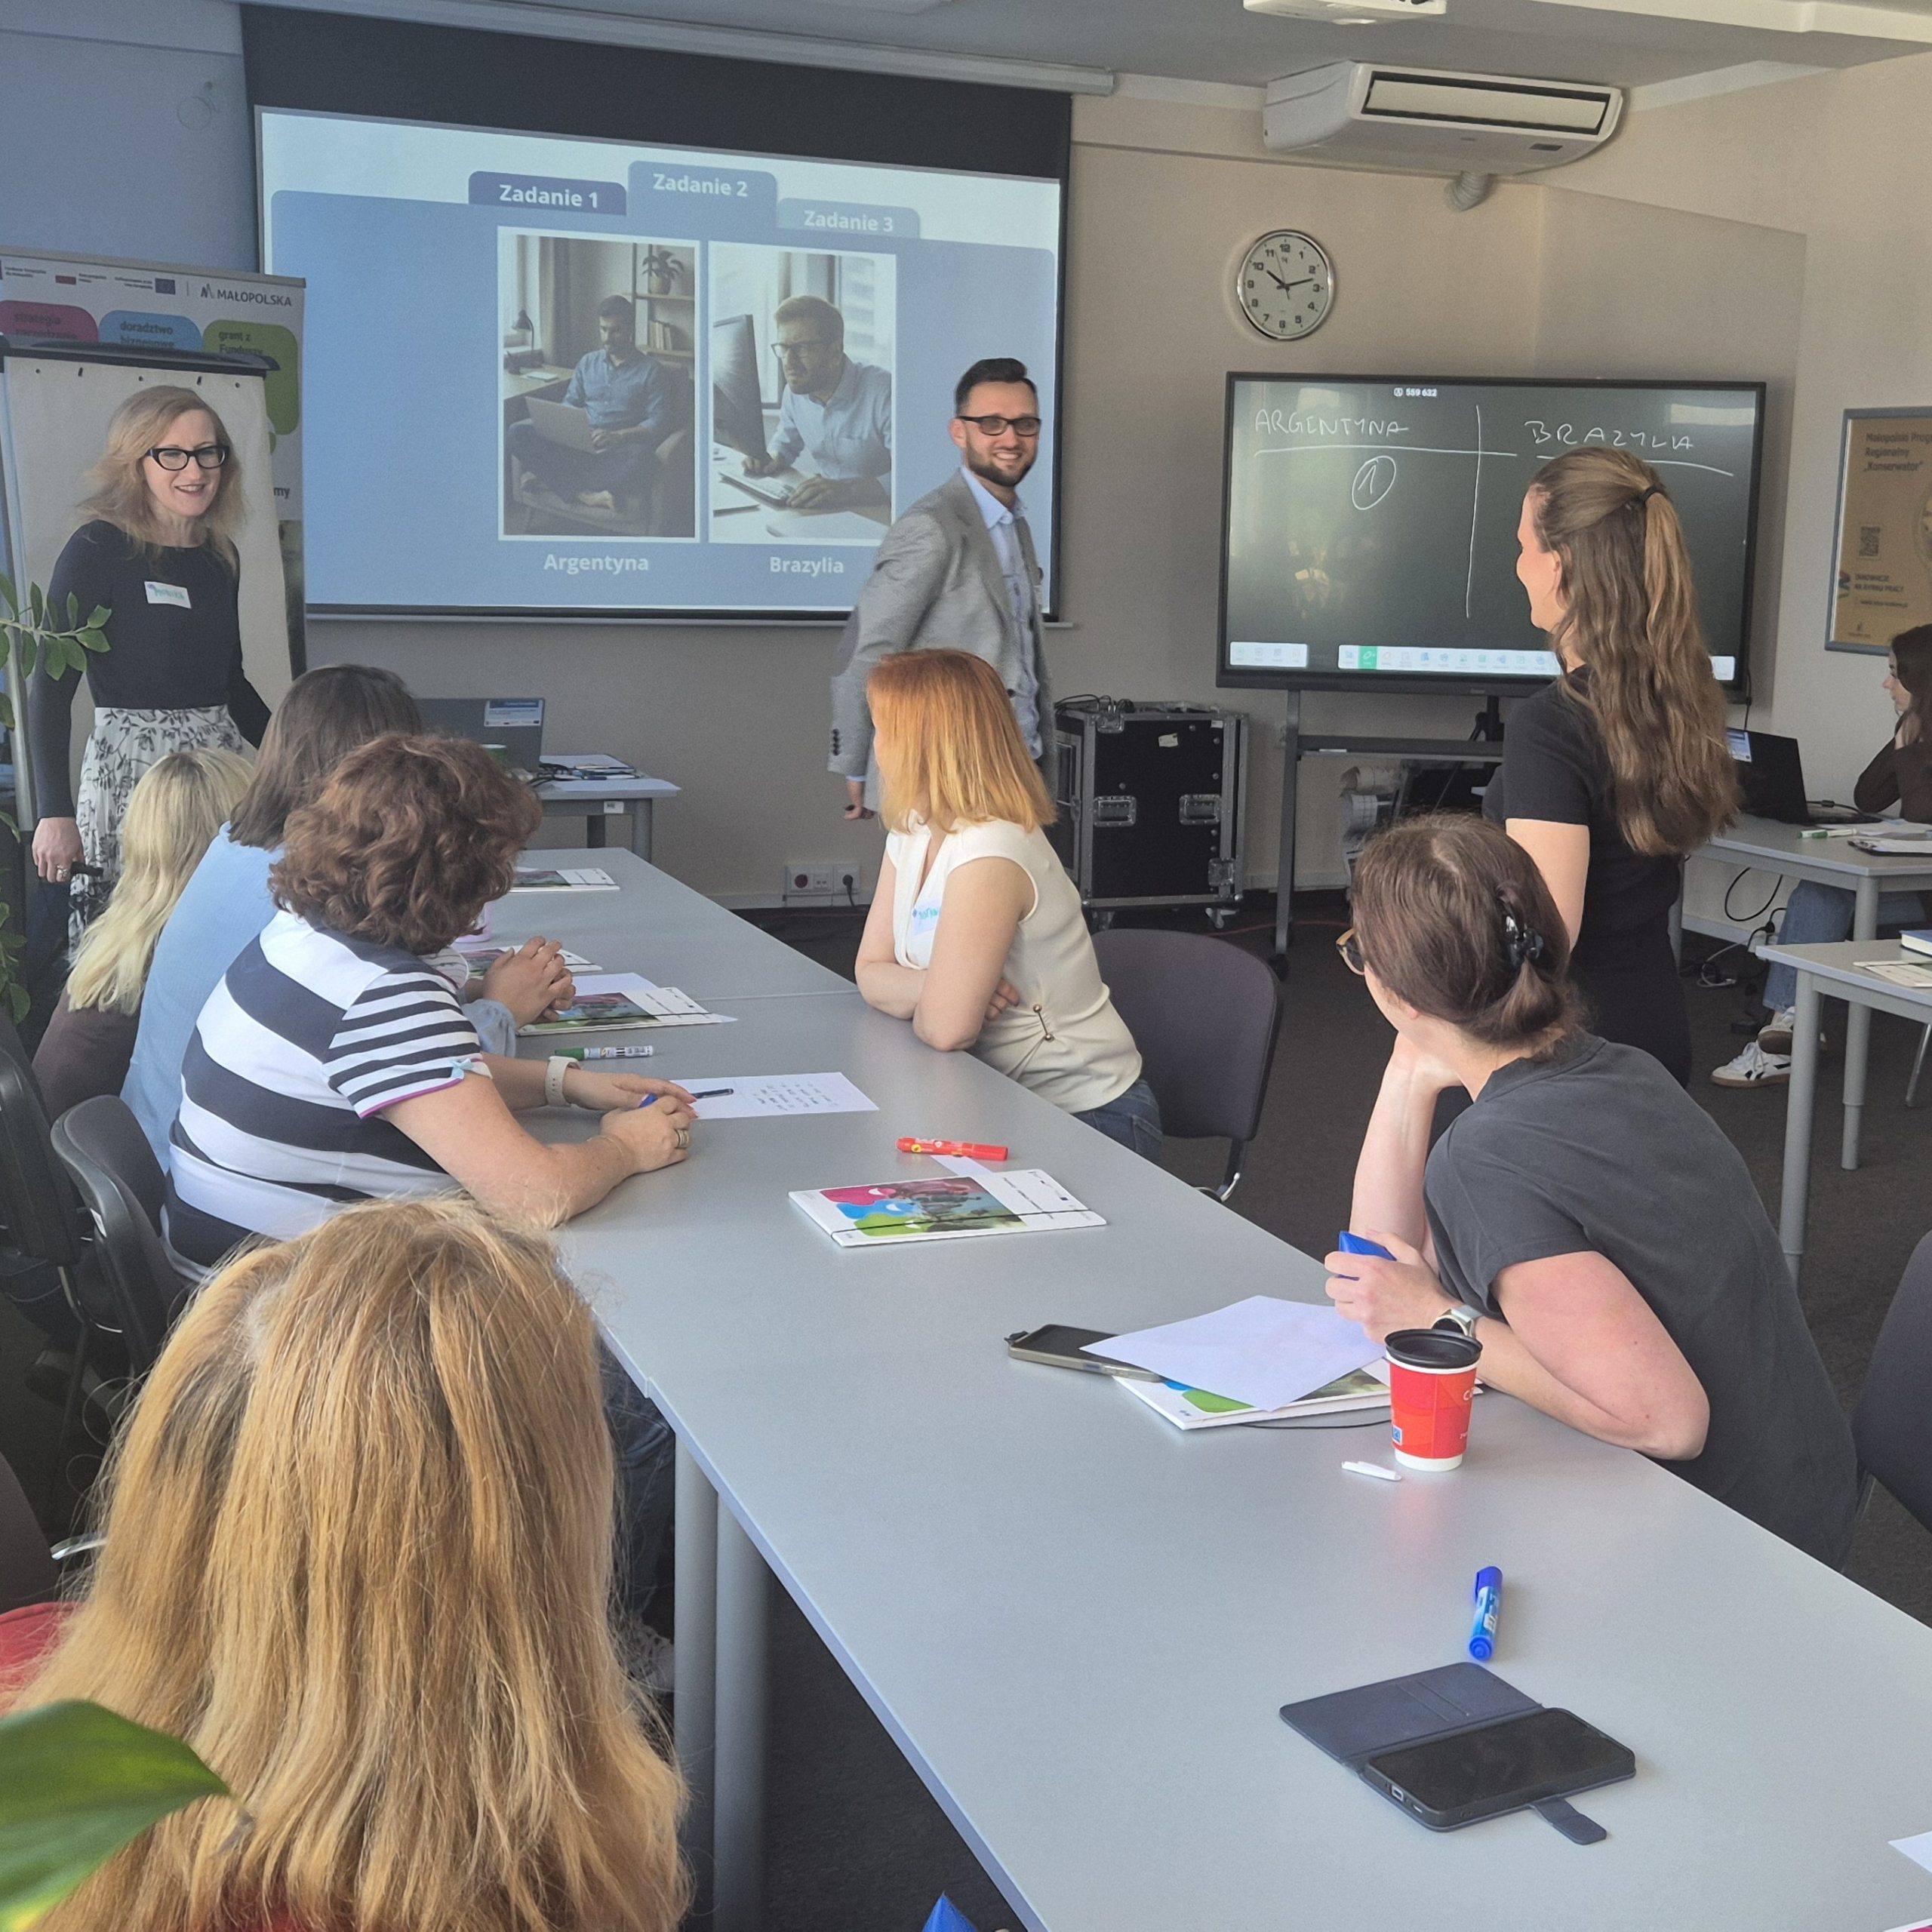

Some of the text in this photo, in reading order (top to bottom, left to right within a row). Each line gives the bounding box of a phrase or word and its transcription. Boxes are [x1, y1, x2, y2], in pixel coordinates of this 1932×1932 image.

[653, 173, 747, 197] Zadanie 2
[499, 184, 598, 208] Zadanie 1
[804, 210, 893, 232] Zadanie 3
[1265, 249, 1275, 257] 11
[1279, 244, 1291, 253] 12
[1299, 251, 1303, 260] 1
[1252, 262, 1264, 270] 10
[1309, 266, 1315, 274] 2
[1247, 280, 1254, 288] 9
[1312, 284, 1320, 292] 3
[217, 289, 292, 306] MAŁOPOLSKA
[1251, 299, 1258, 307] 8
[1263, 313, 1269, 321] 7
[1295, 315, 1302, 324] 5
[119, 321, 174, 334] doradztwo
[1279, 320, 1285, 328] 6
[218, 331, 244, 342] grant
[1255, 409, 1409, 437] ARGENTYNA
[544, 554, 649, 575] Argentyna
[770, 557, 844, 577] Brazylia
